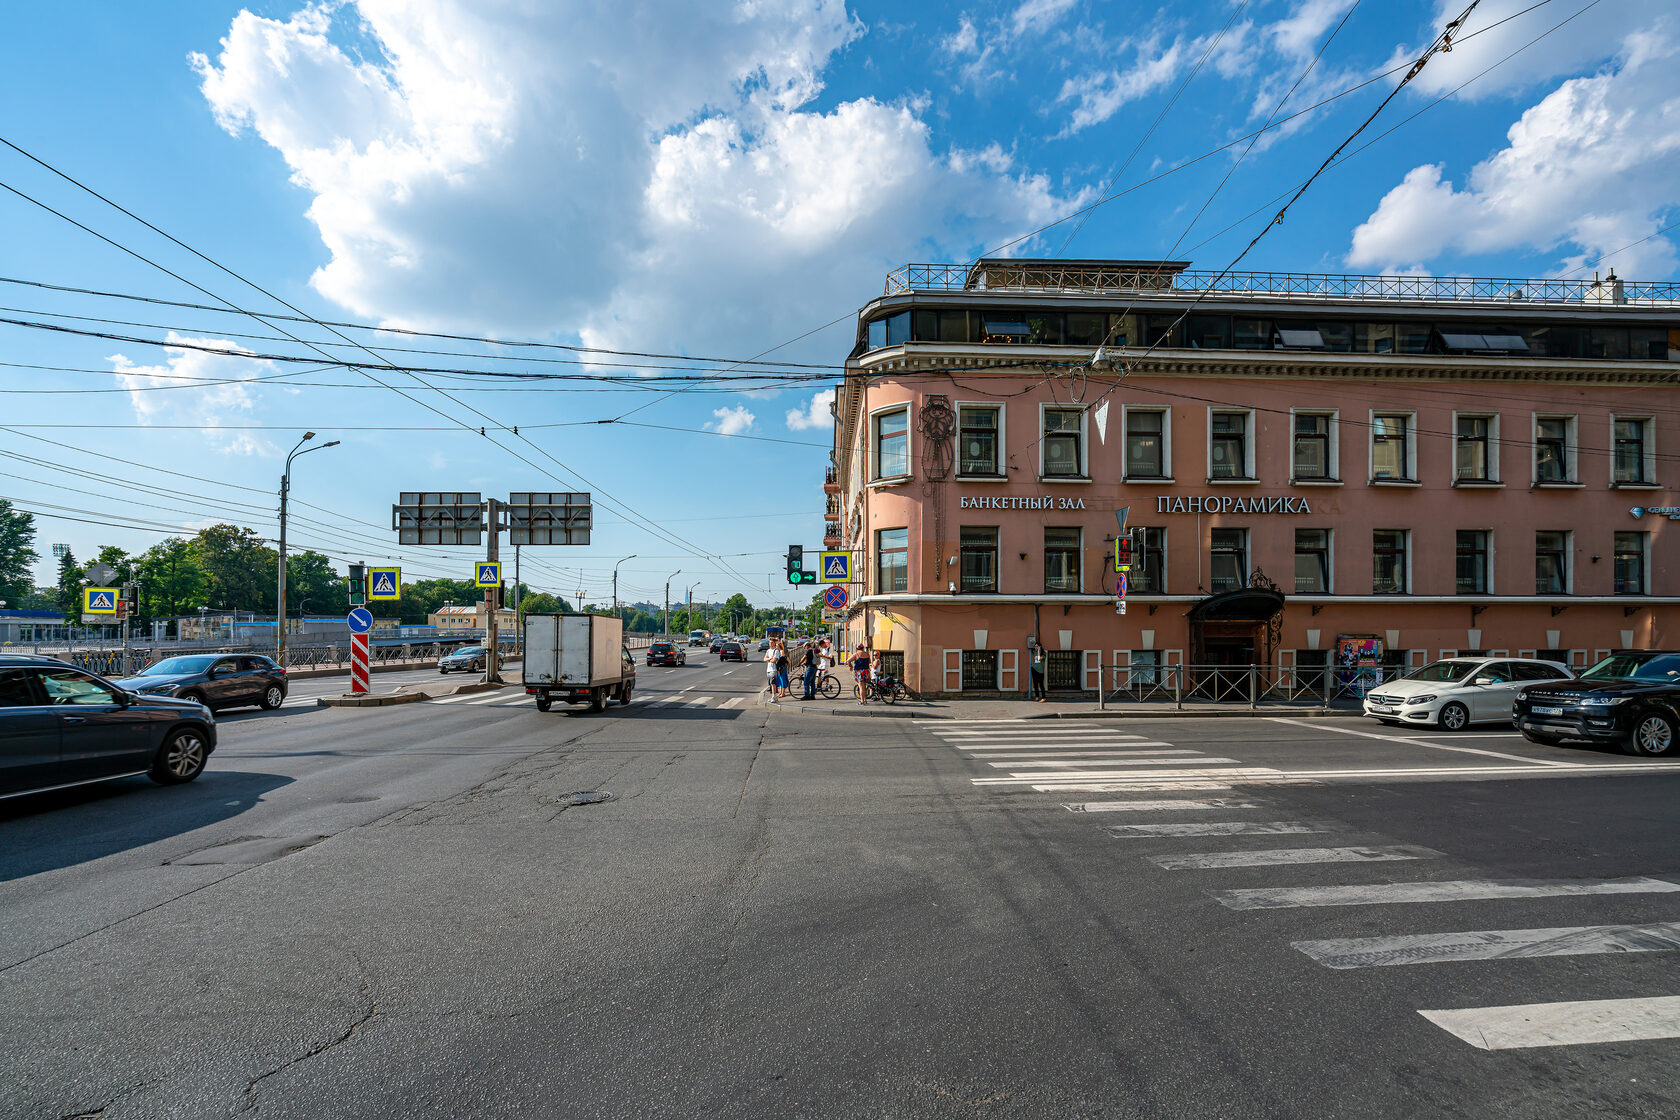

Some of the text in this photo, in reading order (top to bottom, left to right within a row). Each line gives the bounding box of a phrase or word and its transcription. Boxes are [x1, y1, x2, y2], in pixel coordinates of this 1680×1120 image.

[960, 495, 1086, 509] БАНКЕТНЫЙ ЗАЛ
[1157, 495, 1311, 514] ПАНОРАМИКА
